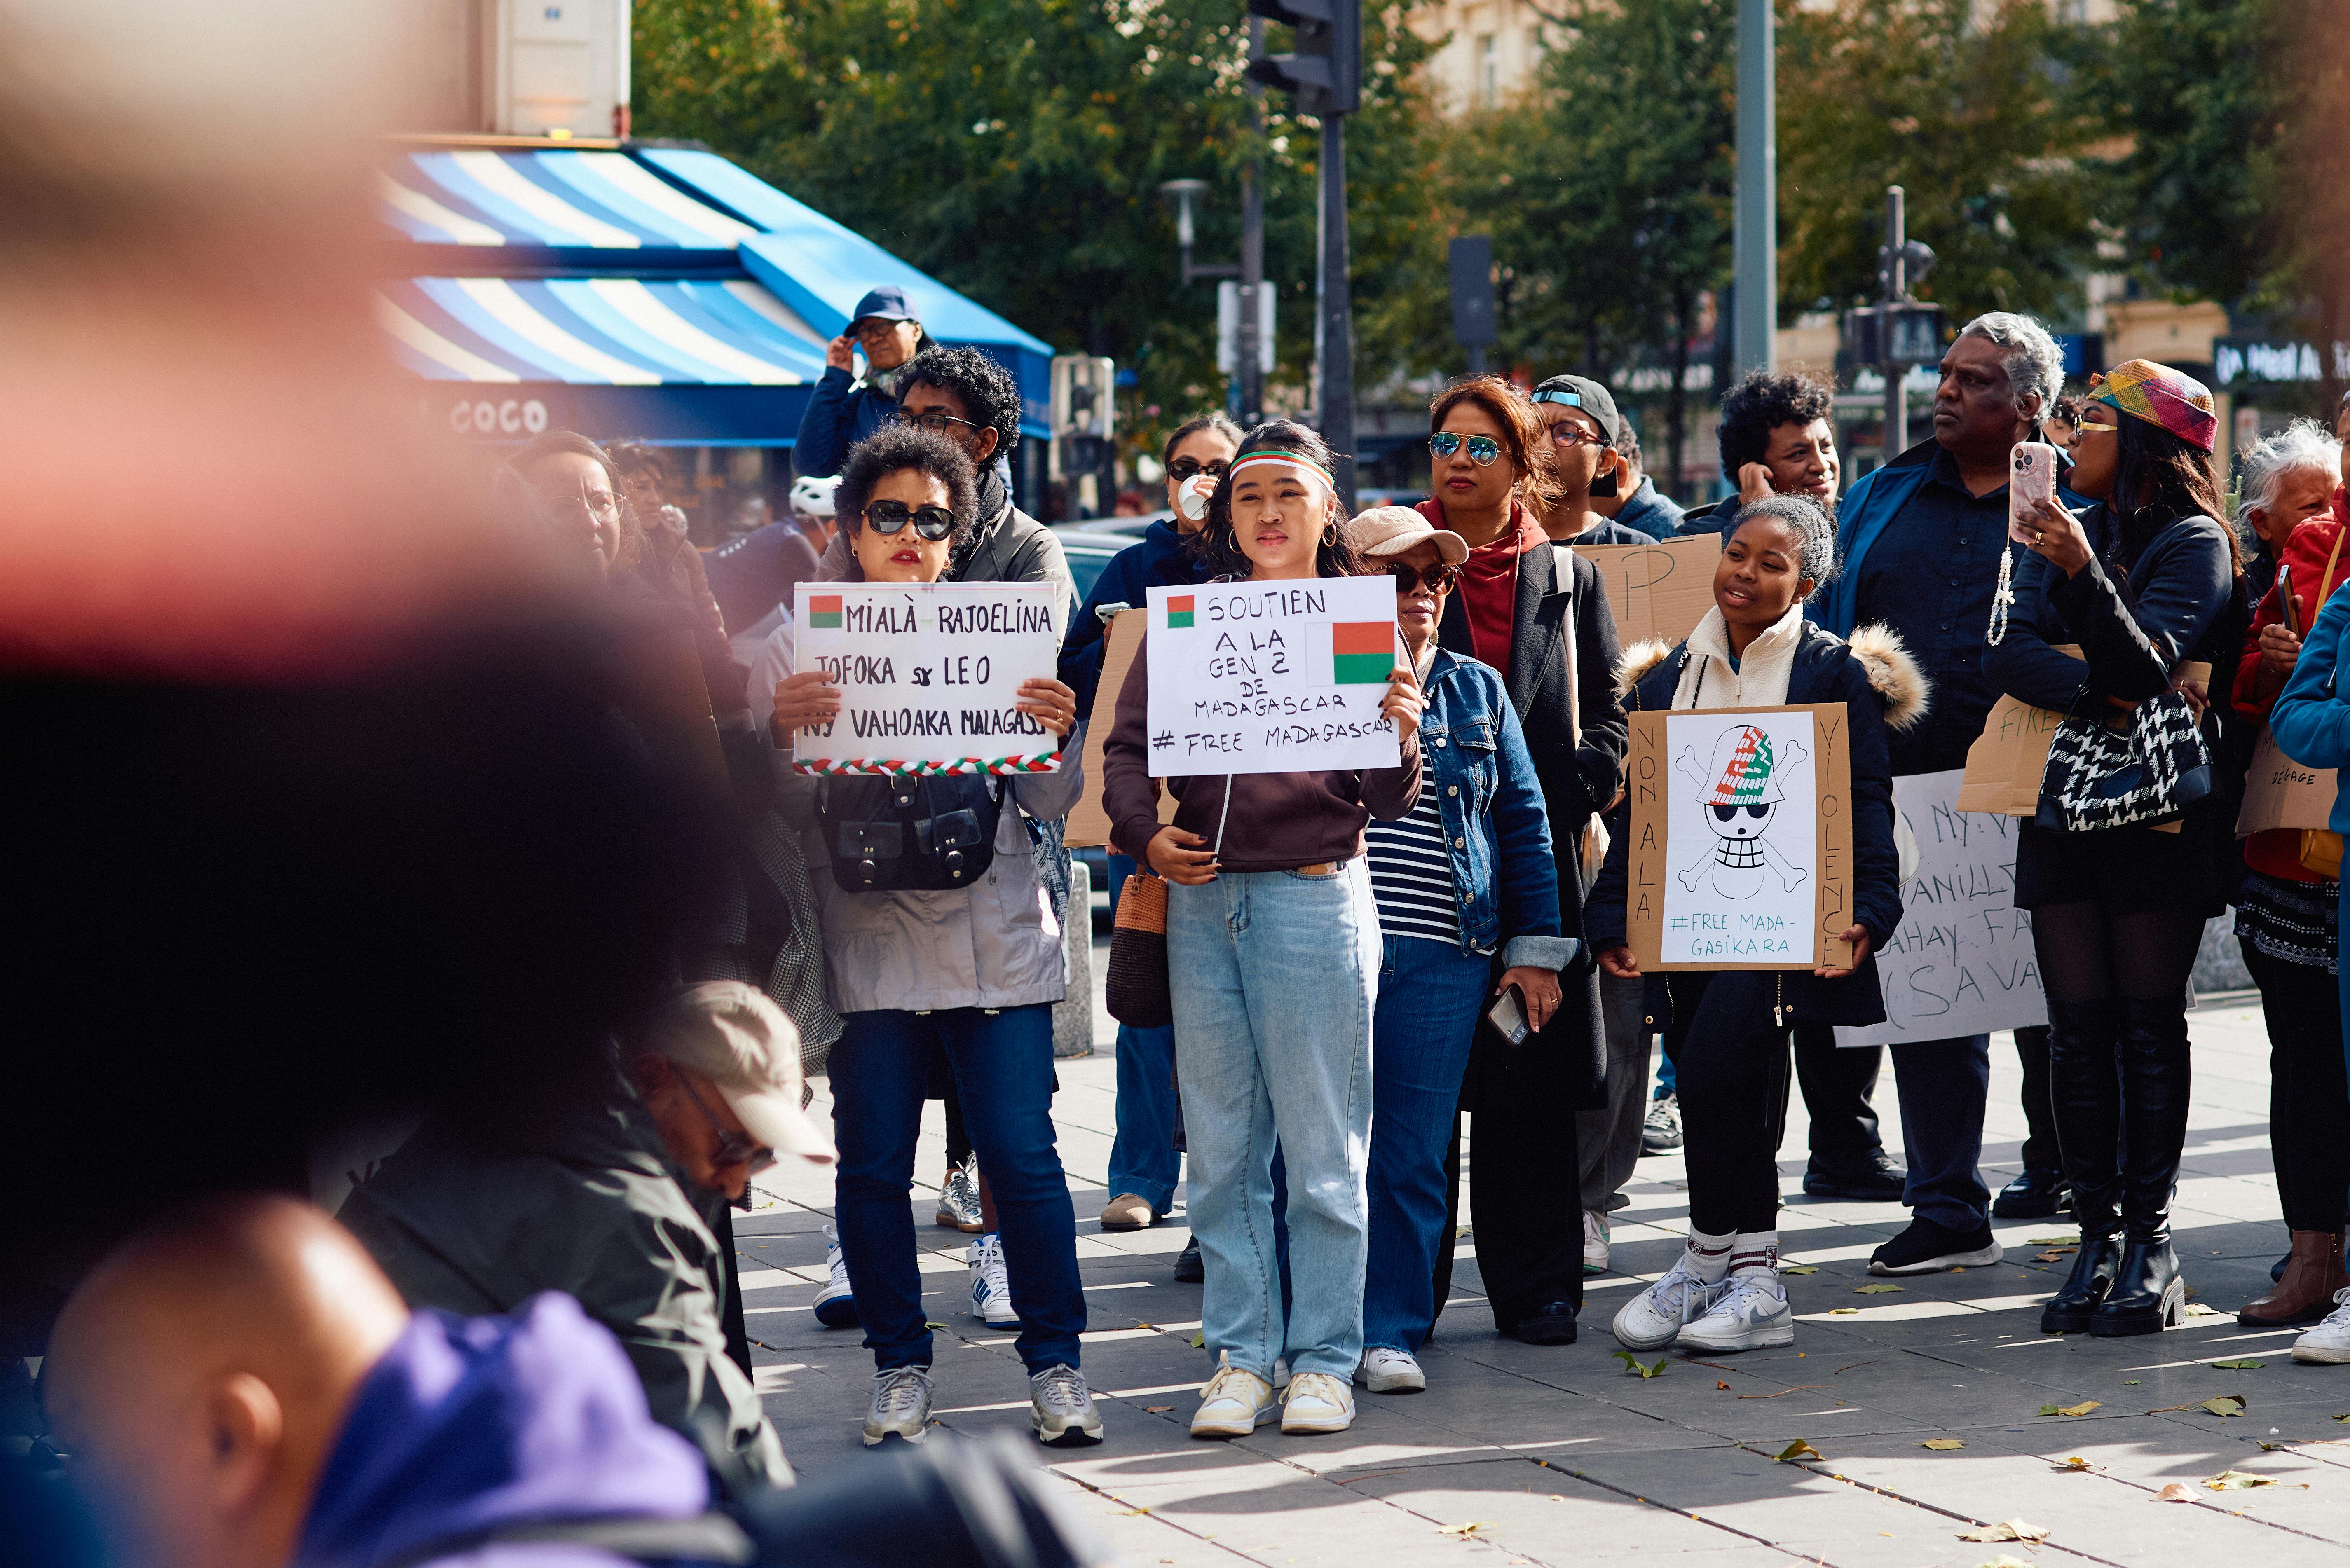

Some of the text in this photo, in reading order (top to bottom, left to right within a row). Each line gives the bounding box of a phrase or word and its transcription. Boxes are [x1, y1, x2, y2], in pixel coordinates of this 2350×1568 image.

[450, 399, 548, 433] COCO
[1209, 590, 1326, 620] SOUTIEN
[1215, 629, 1285, 651] A LA
[814, 655, 896, 686] TOFOKA
[944, 655, 990, 685] LEO
[1209, 655, 1256, 678] GEN
[1240, 678, 1268, 697] DE
[1195, 693, 1346, 720] MADAGASCAR
[850, 708, 952, 738] VAHOAKA
[1266, 718, 1393, 747] MADAGASCAR
[1638, 726, 1656, 805] NON
[1670, 913, 1727, 931] #FREE
